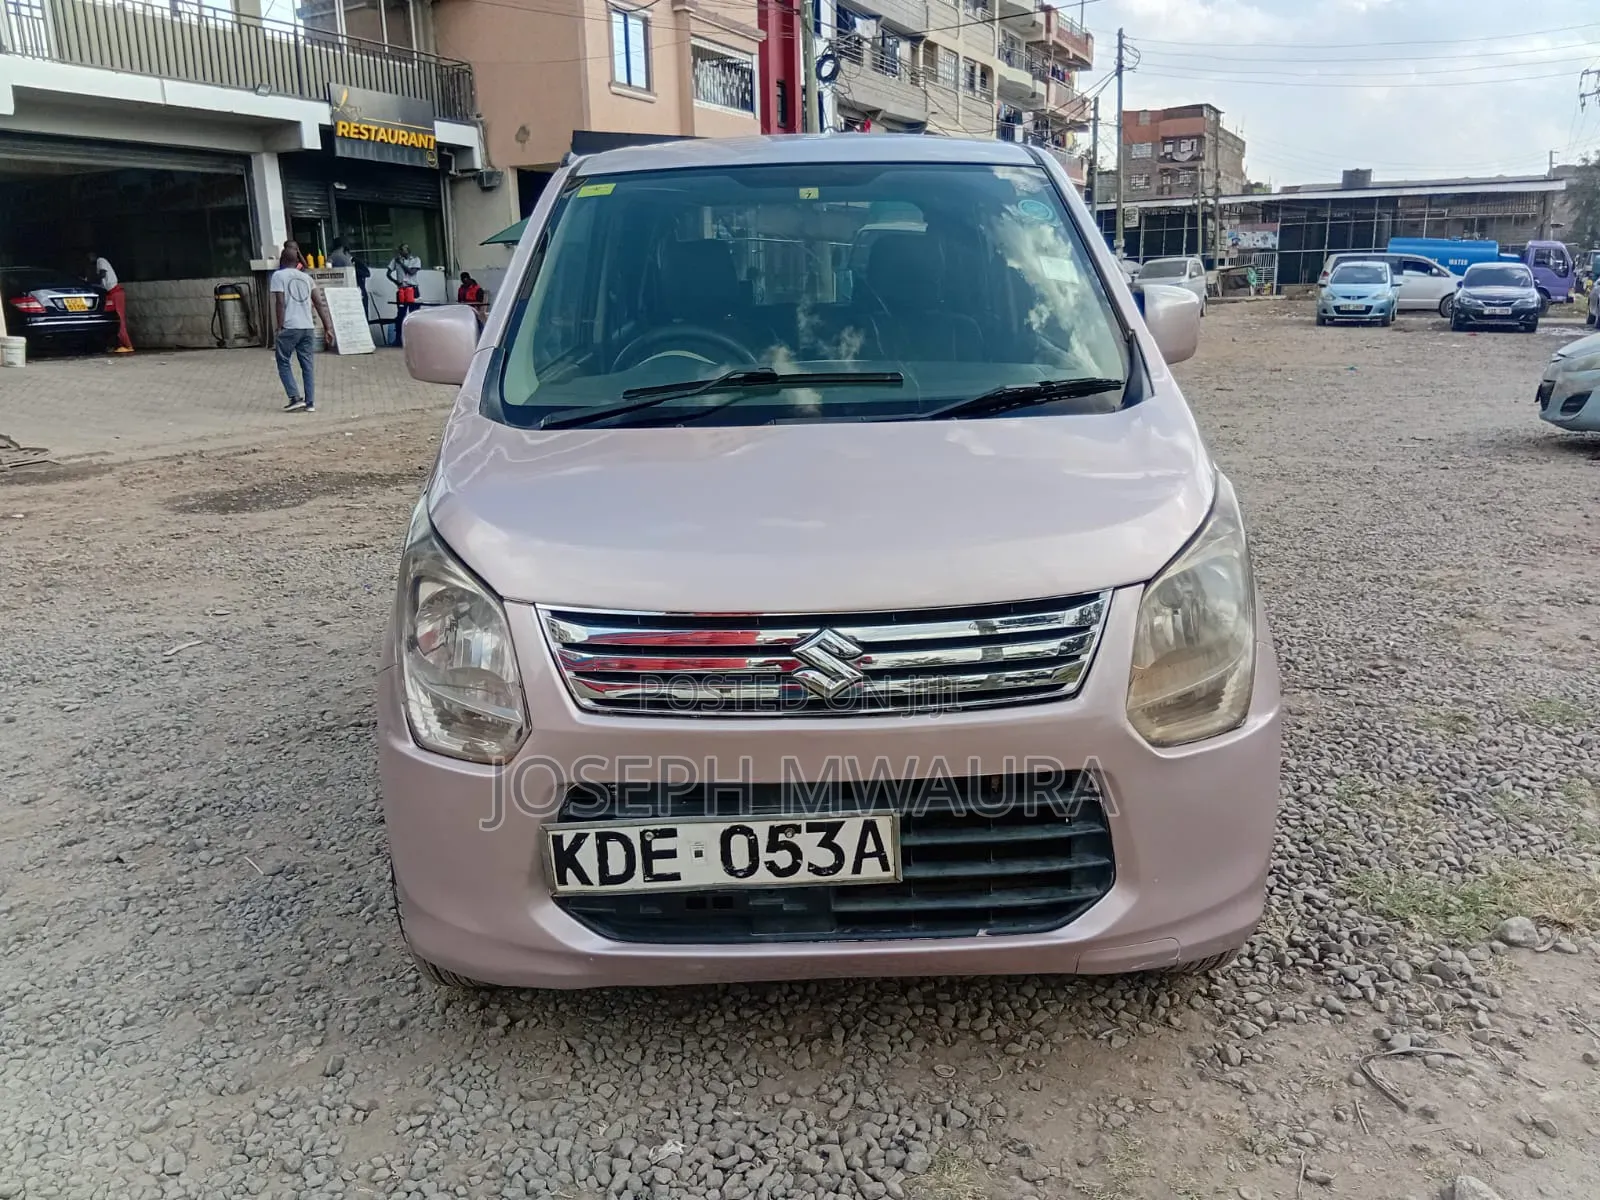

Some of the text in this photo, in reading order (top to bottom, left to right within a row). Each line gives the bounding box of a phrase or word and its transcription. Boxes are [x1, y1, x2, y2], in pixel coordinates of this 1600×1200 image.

[336, 120, 436, 150] RESTAURANT
[551, 819, 891, 887] KDE 053A
